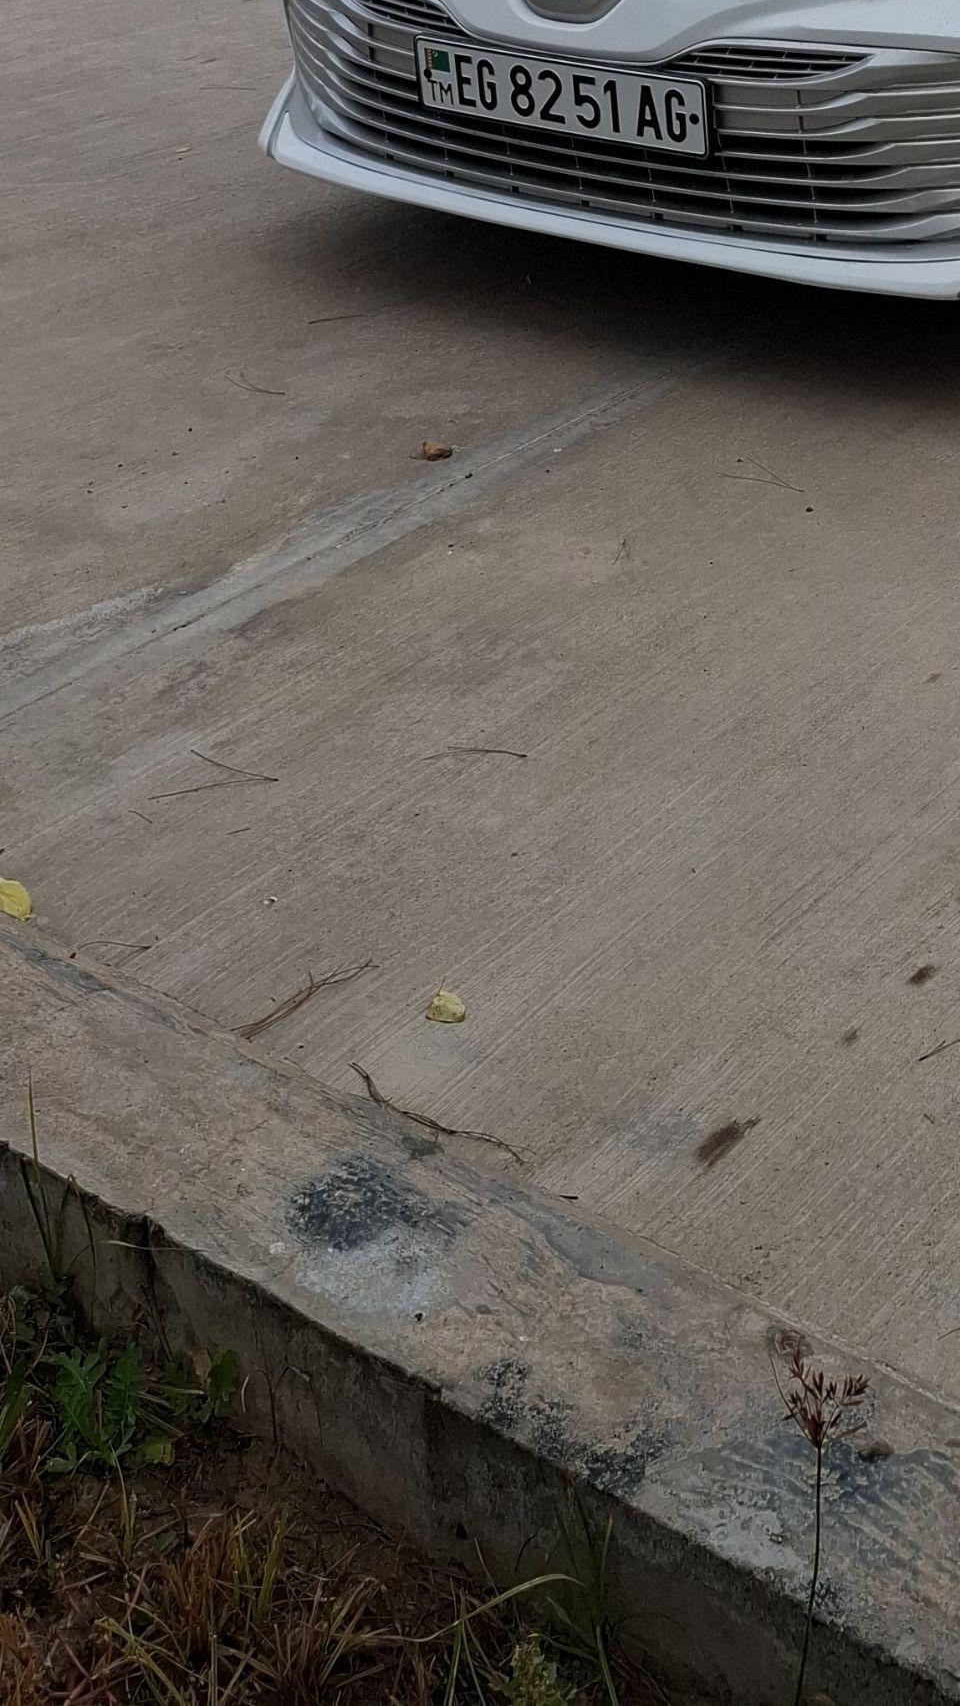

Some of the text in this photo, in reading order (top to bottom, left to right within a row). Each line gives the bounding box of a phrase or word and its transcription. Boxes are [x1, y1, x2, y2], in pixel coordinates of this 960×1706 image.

[427, 79, 454, 105] TM
[454, 53, 688, 143] EG 8251 AG
